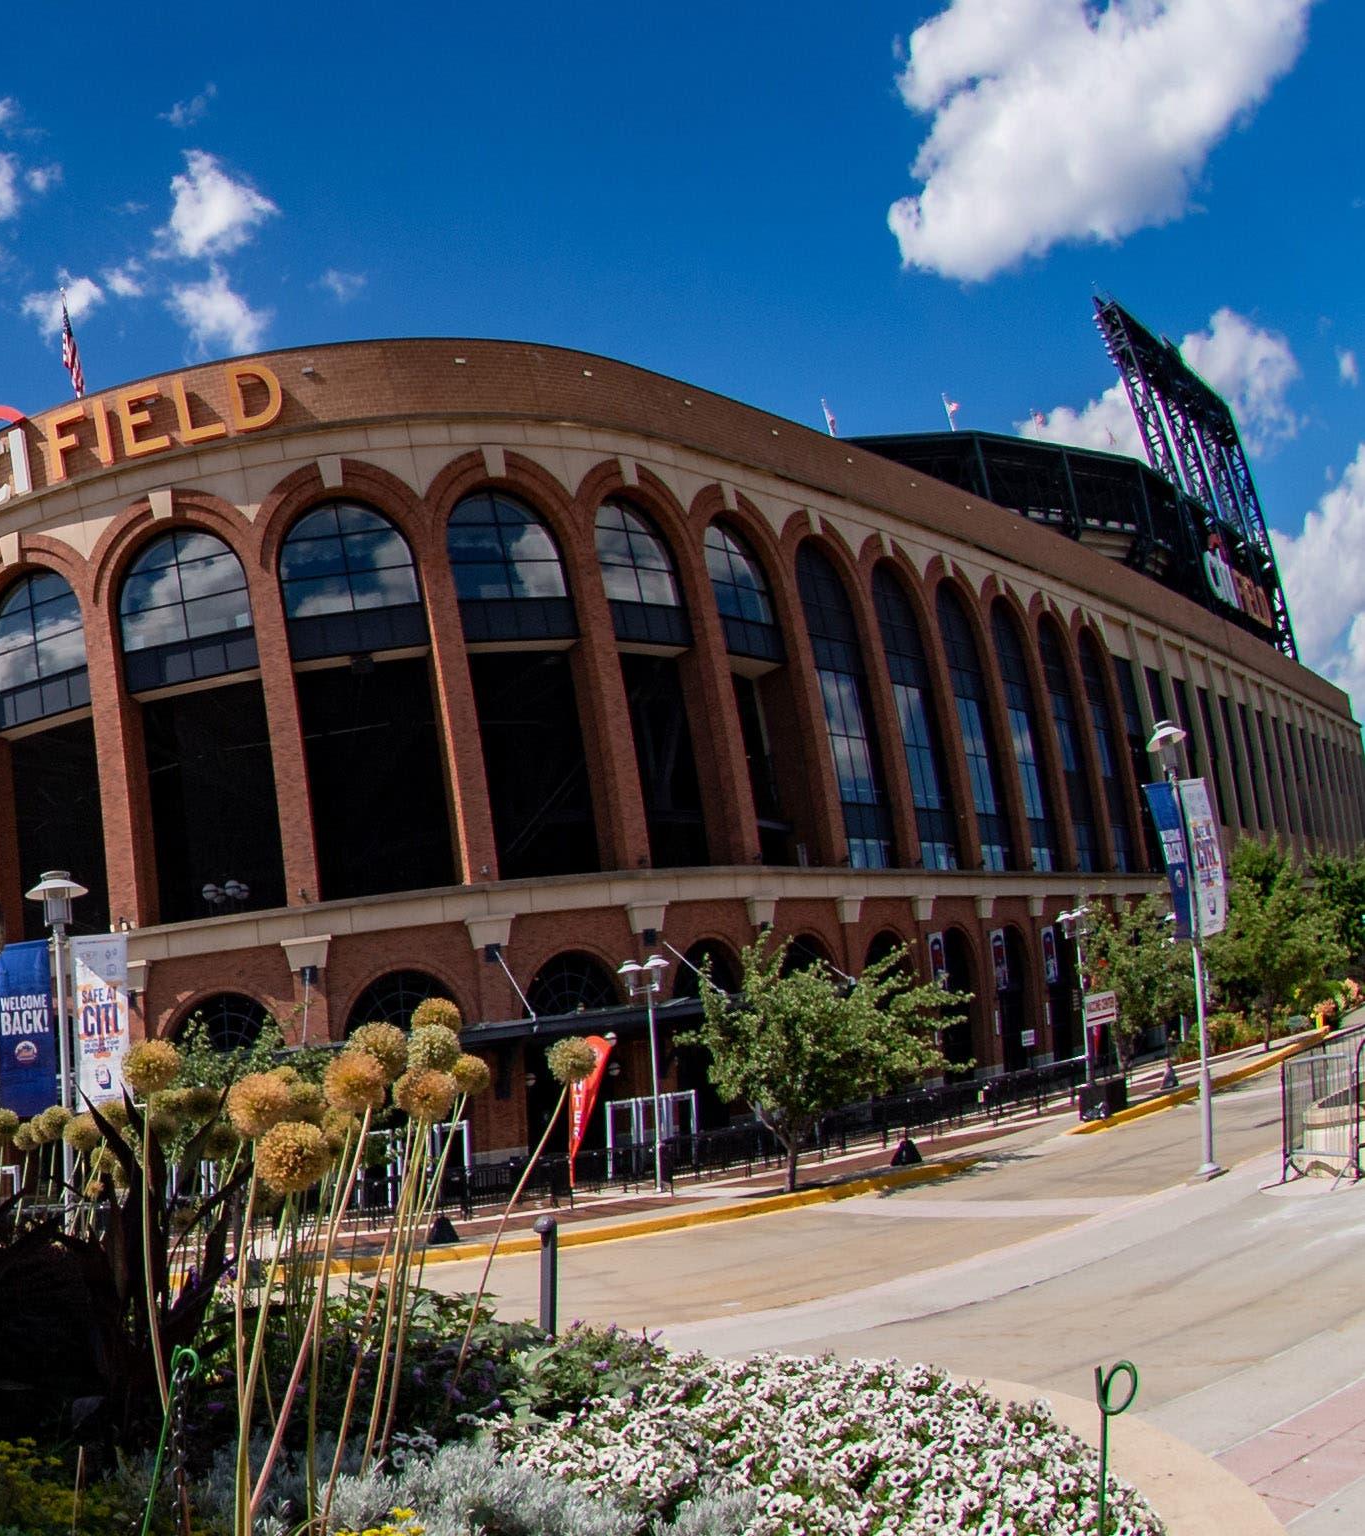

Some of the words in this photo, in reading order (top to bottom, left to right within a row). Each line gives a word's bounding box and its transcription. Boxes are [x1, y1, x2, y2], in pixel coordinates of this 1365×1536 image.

[45, 364, 283, 480] FIELD
[0, 993, 48, 1011] WELCOME
[81, 988, 105, 1004] SAFE
[106, 986, 117, 1001] AT
[0, 1009, 49, 1036] BACK!
[83, 1002, 120, 1037] CITI
